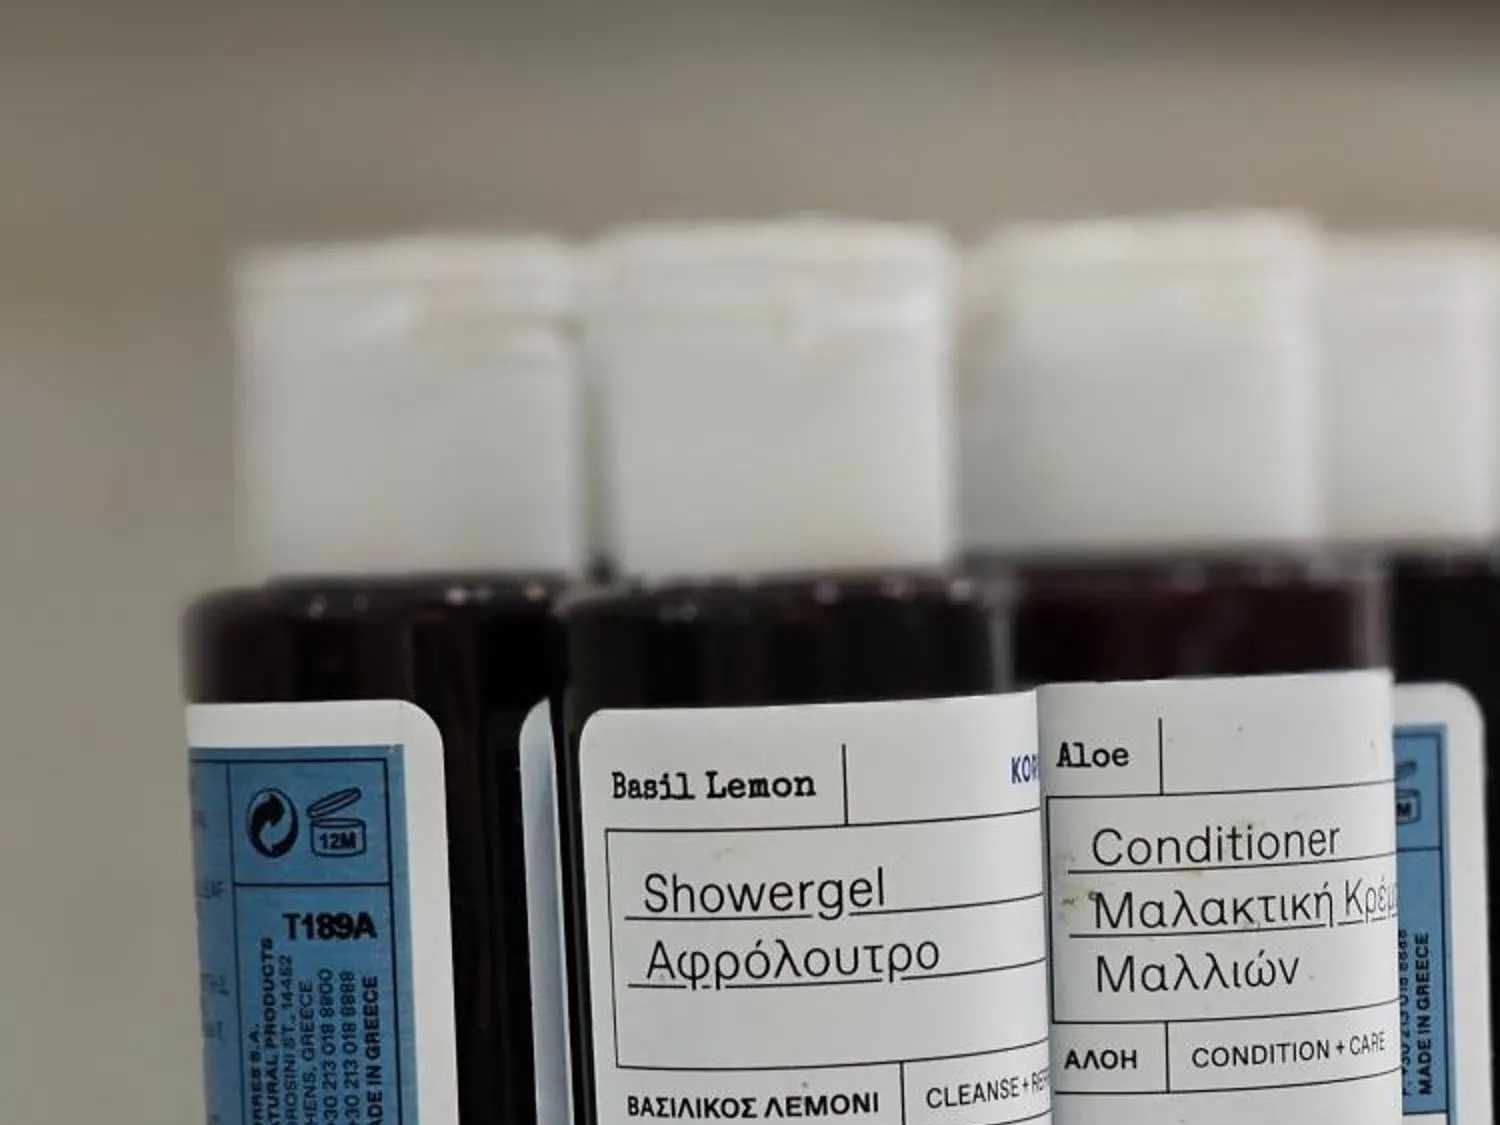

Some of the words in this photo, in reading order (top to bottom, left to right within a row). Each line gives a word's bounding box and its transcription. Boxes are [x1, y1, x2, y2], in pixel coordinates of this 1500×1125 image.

[1056, 742, 1129, 768] Aloe
[611, 771, 696, 800] Basil
[705, 770, 816, 799] Lemon
[319, 831, 356, 850] 12M
[1092, 824, 1341, 867] Conditioner
[643, 866, 885, 920] Showergel
[1094, 882, 1334, 930] Μαλακτική
[282, 912, 378, 940] T189A
[646, 939, 940, 991] Αφρόλουτρο
[1096, 949, 1300, 993] Μαλλιών
[1414, 931, 1431, 1011] GREECE
[261, 938, 279, 1049] PRODUCTS
[299, 980, 317, 1061] GREECE
[362, 975, 382, 1060] GREECE
[1416, 1014, 1432, 1034] IN
[320, 1023, 337, 1055] 018
[1191, 1040, 1330, 1069] CONDITION
[1349, 1031, 1386, 1055] CARE
[321, 1060, 338, 1090] 213
[343, 1058, 359, 1089] 213
[365, 1065, 383, 1086] IN
[1064, 1049, 1138, 1070] ΑΛΟΗ
[1417, 1039, 1433, 1096] MADE
[627, 1094, 758, 1119] ΒΑΣΙΛΙΚΟΣ
[764, 1092, 880, 1118] ΛΕΜΟΝΙ
[926, 1076, 1020, 1109] CLEANSE
